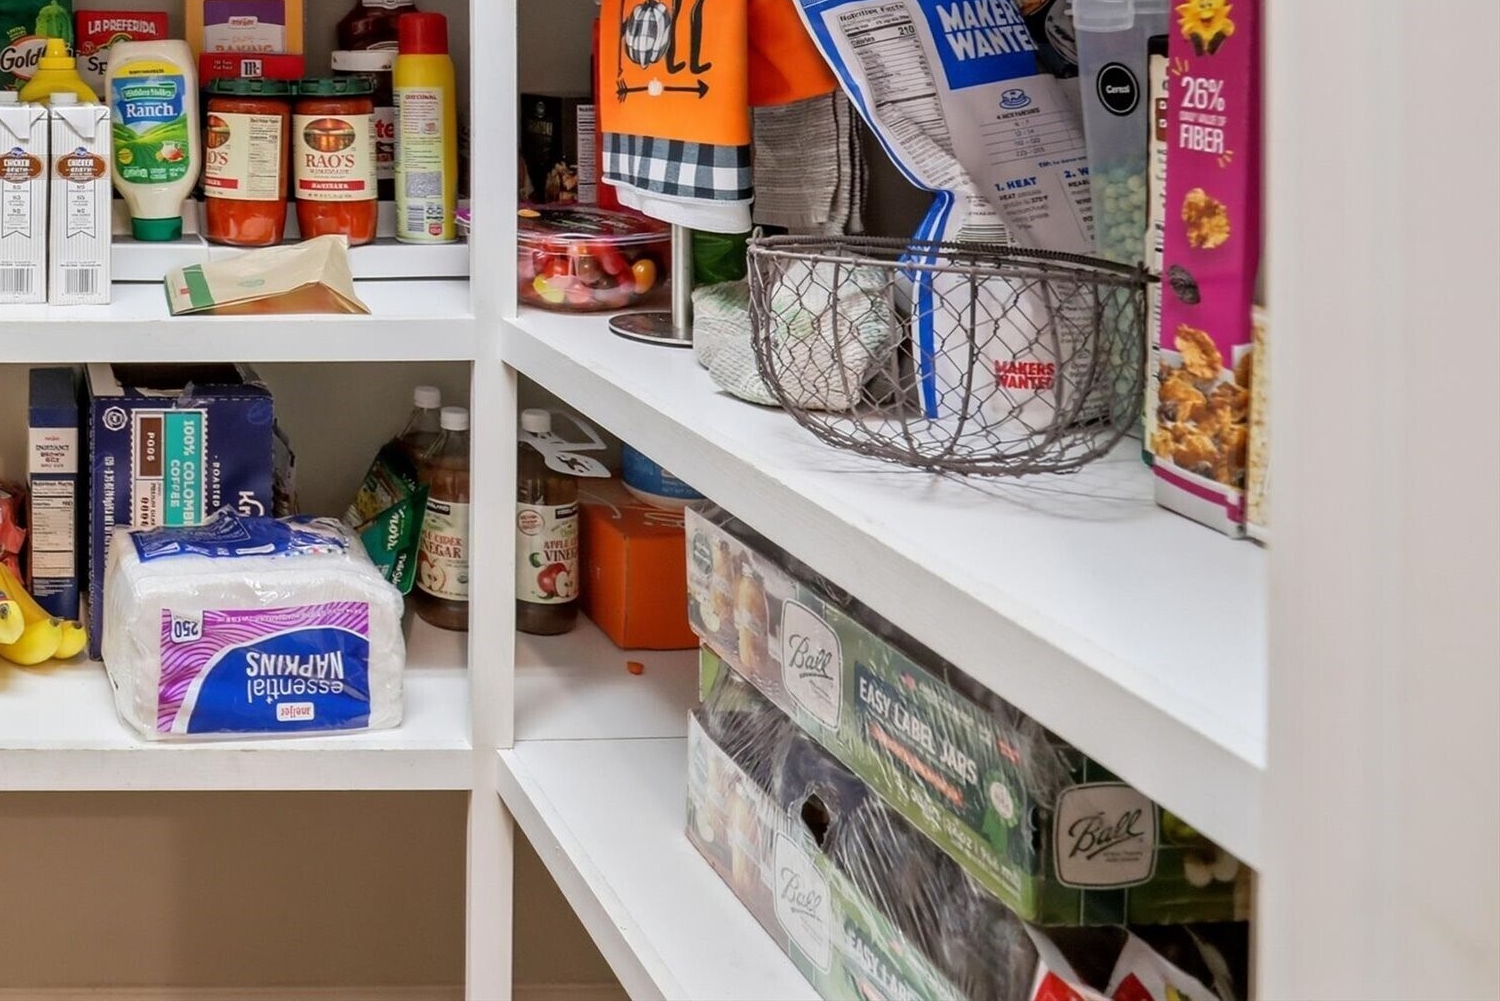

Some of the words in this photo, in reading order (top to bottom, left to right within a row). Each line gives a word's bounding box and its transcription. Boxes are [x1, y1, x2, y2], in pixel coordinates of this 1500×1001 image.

[88, 21, 102, 35] LA
[102, 19, 158, 34] PREFERIDA
[0, 46, 49, 71] Gold
[1106, 84, 1130, 94] Cereal
[1180, 76, 1226, 112] 26%
[126, 102, 178, 118] Ranch
[1179, 125, 1225, 154] FIBER
[305, 154, 355, 169] RAO'S
[1006, 177, 1037, 190] HEAT
[994, 360, 1056, 376] MAKERS
[994, 374, 1055, 390] WANTED
[147, 432, 156, 462] PODS
[183, 420, 195, 456] 100%
[170, 460, 181, 508] COFFEE
[212, 462, 221, 507] ROASTED
[421, 540, 462, 560] NEGAR
[173, 620, 199, 638] 250
[246, 650, 344, 679] NAPKINS
[789, 634, 833, 674] Ball
[247, 676, 345, 705] essential
[859, 677, 891, 709] EASY
[892, 702, 936, 754] LABEL
[939, 743, 978, 784] JARS
[1068, 808, 1147, 859] Ball
